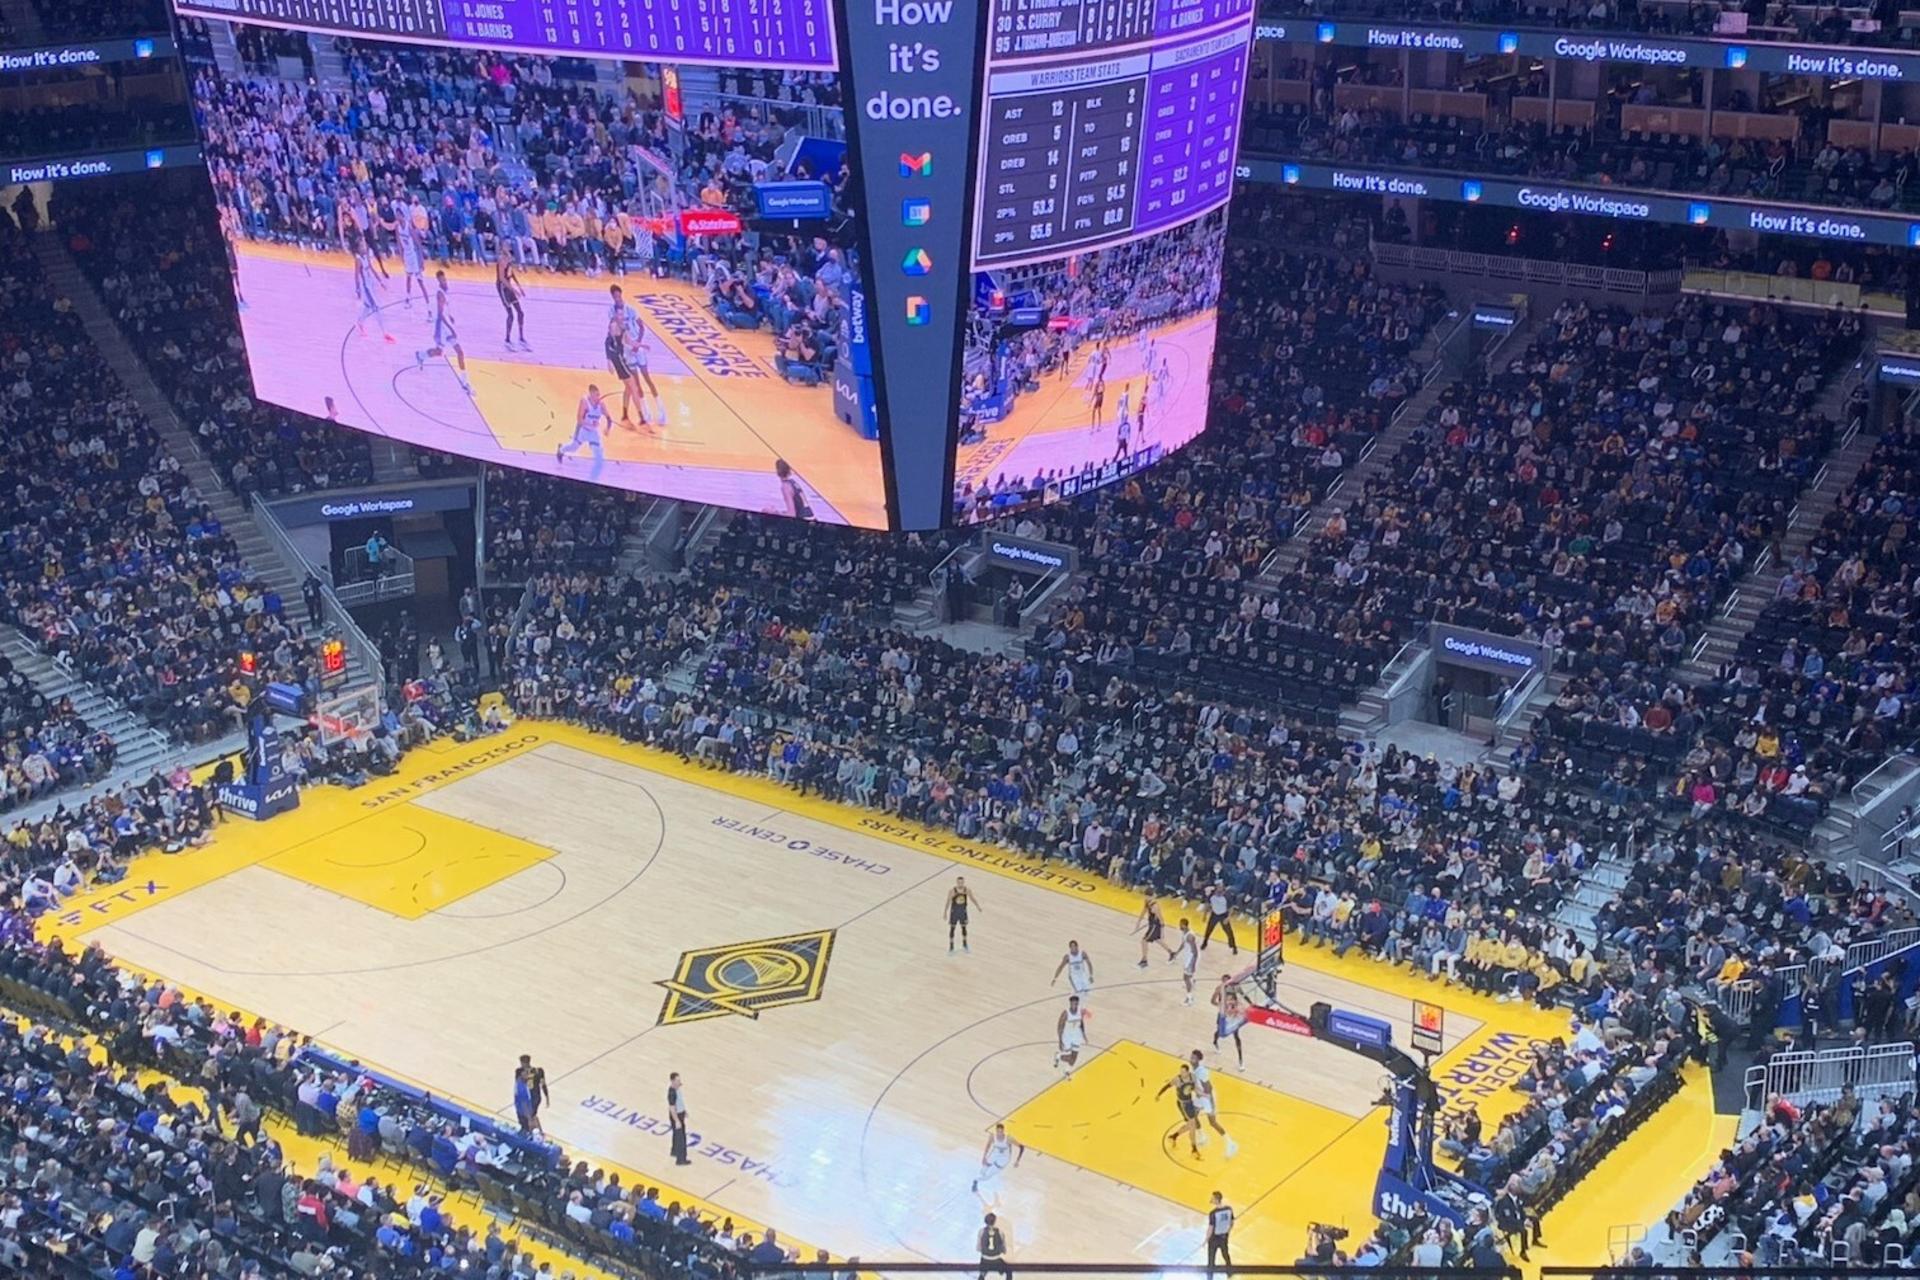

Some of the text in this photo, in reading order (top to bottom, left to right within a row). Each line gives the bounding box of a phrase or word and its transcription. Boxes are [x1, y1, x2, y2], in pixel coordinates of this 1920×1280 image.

[475, 4, 504, 20] JONES
[543, 8, 553, 23] 11
[568, 10, 578, 25] 11
[595, 12, 603, 27] 2
[621, 13, 629, 28] 2
[648, 15, 654, 30] 1
[674, 16, 681, 31] 1
[806, 21, 814, 37] 0
[804, 1, 813, 16] 2
[875, 0, 953, 25] How
[997, 16, 1012, 32] 30
[1028, 12, 1062, 30] CURRY
[1107, 5, 1115, 21] 0
[1126, 3, 1133, 18] 5
[1143, 0, 1150, 16] 2
[476, 22, 514, 39] BARNES
[545, 27, 557, 42] 13
[572, 29, 580, 44] 9
[598, 32, 605, 46] 1
[624, 33, 631, 48] 0
[650, 34, 657, 49] 0
[676, 36, 684, 51] 0
[809, 41, 816, 57] 1
[996, 36, 1011, 53] 95
[1105, 25, 1113, 41] 2
[1125, 23, 1131, 38] 1
[1142, 20, 1148, 35] 1
[1368, 29, 1464, 49] How it's done.
[0, 49, 100, 69] How it's done.
[889, 42, 940, 73] it's
[1555, 38, 1687, 64] Google Workspace
[1031, 61, 1121, 87] WARRIORS TEAM STATS
[1788, 54, 1903, 77] How it's done.
[866, 90, 962, 120] done.
[1128, 88, 1135, 103] 2
[1004, 100, 1064, 119] AST 12
[1003, 125, 1061, 145] OREB 5
[1084, 123, 1095, 133] TO
[1048, 150, 1059, 166] 14
[1082, 137, 1131, 158] POT 15
[11, 160, 111, 182] How it's done.
[1118, 160, 1128, 176] 14
[999, 174, 1057, 195] STL 5
[1333, 172, 1427, 195] How it's done.
[1518, 188, 1649, 217] Google Workspace
[1750, 211, 1865, 239] How it's done.
[661, 293, 728, 341] GOLDEN
[851, 290, 865, 344] betway
[634, 294, 743, 376] WARRIORS
[321, 500, 413, 516] Google Workspace
[993, 542, 1020, 559] Google
[1445, 637, 1532, 666] Google Workspace
[361, 734, 539, 809] SAN FRANCISCO
[218, 788, 257, 812] thrive
[712, 815, 891, 876] CHASE CENTER
[858, 818, 1096, 893] CELEBRATING 75 YEARS
[581, 1094, 673, 1136] CENTER
